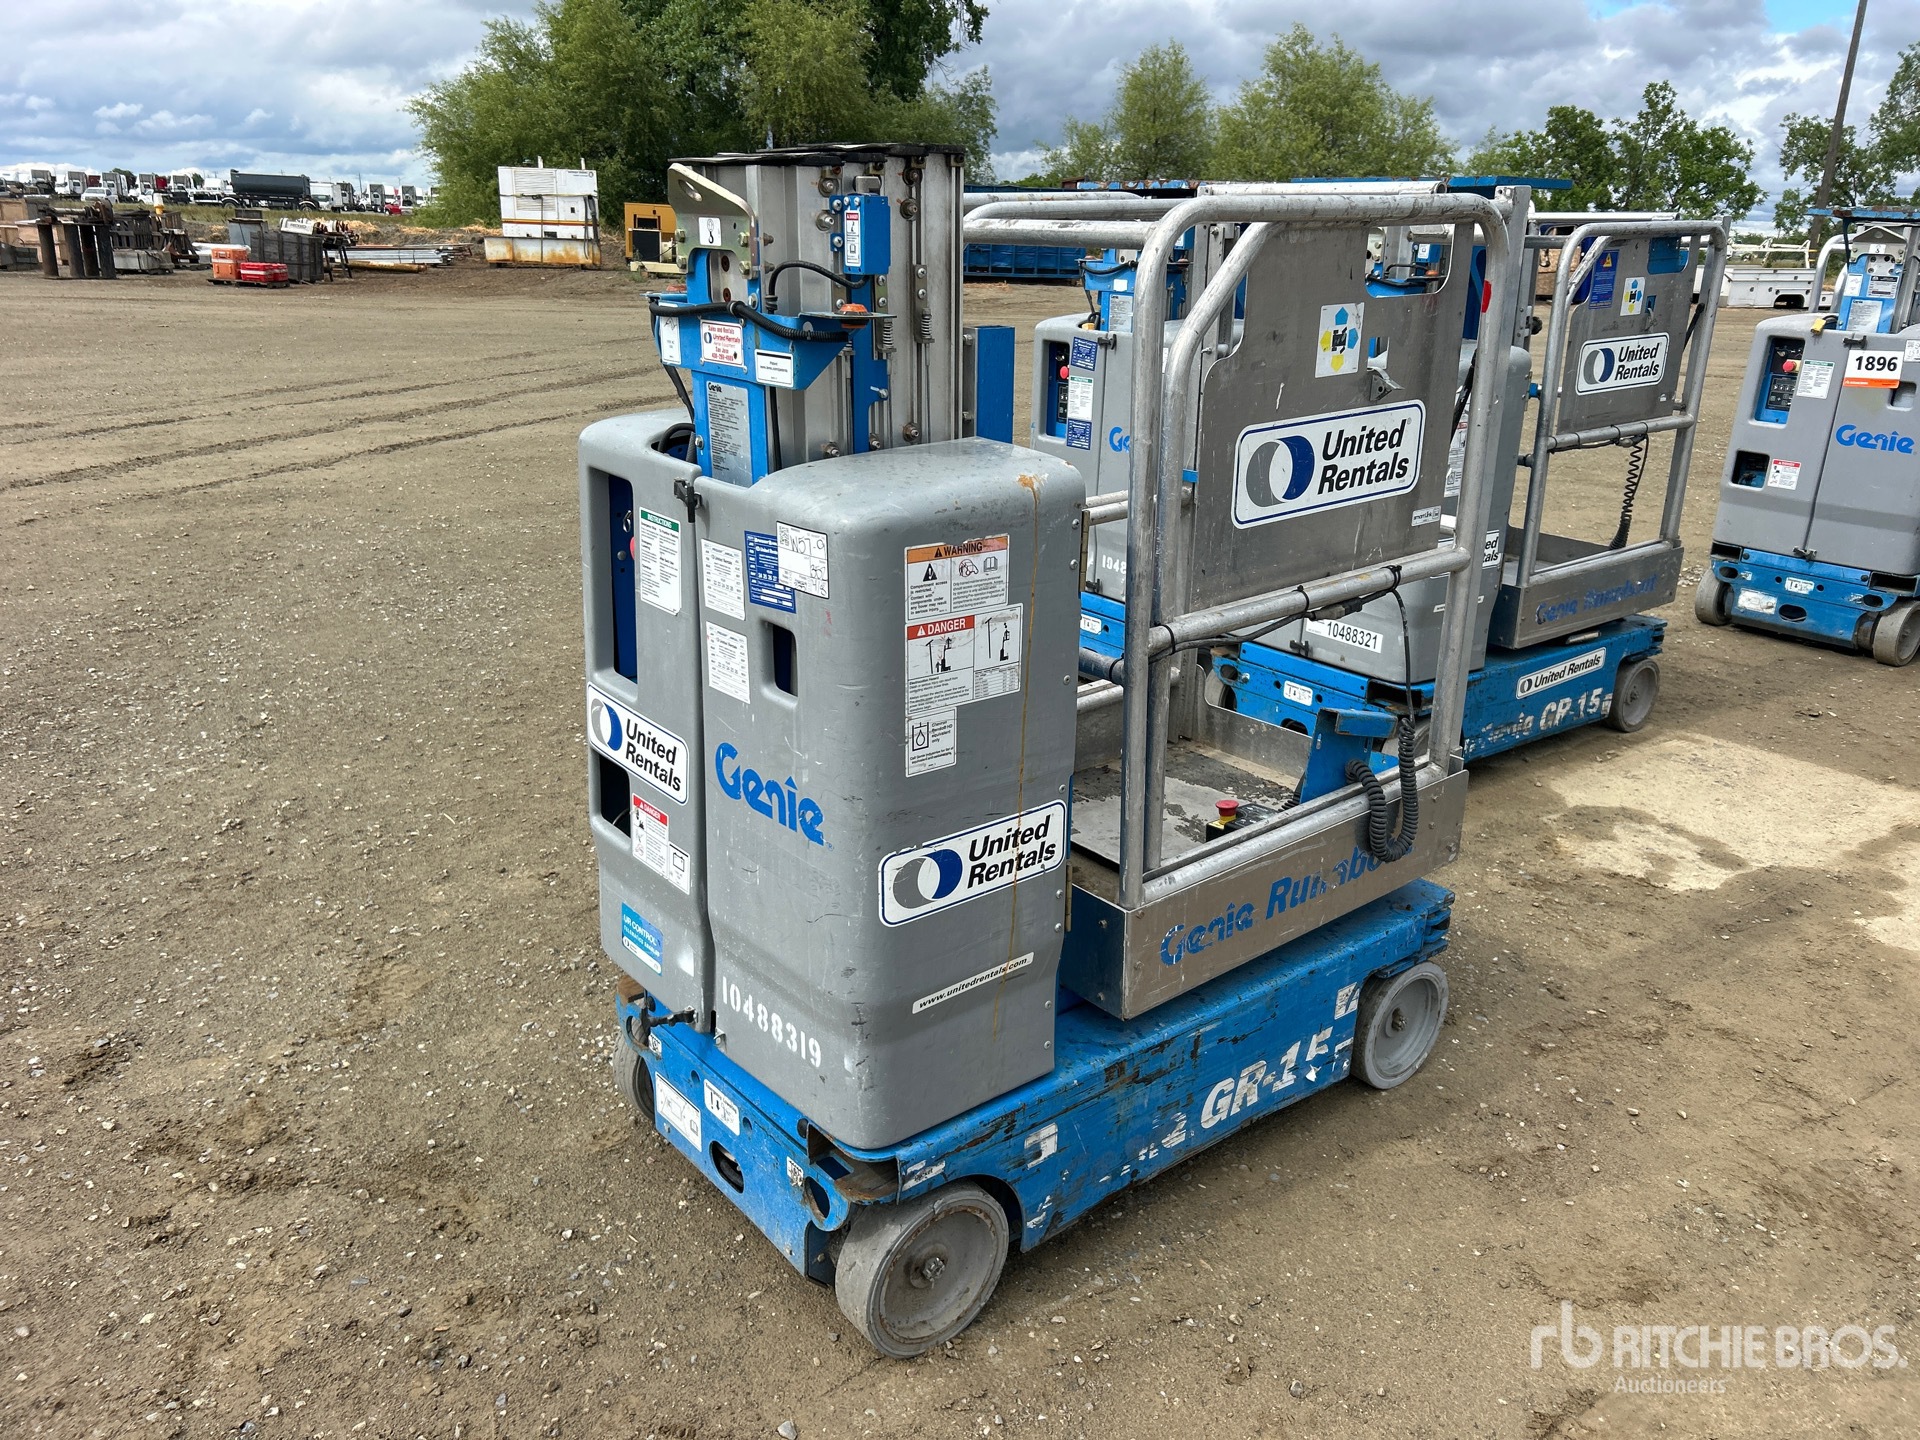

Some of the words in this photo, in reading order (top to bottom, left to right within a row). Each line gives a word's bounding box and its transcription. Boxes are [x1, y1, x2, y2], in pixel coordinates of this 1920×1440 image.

[1614, 361, 1660, 381] Rentals
[1618, 343, 1660, 363] United
[1856, 356, 1898, 371] 1896
[1322, 418, 1406, 460] United
[1836, 424, 1914, 454] Genie
[1318, 452, 1409, 494] Rentals
[648, 514, 672, 528] INSTRUCTIONS
[944, 542, 982, 556] WARNING
[928, 618, 965, 635] DANGER
[1327, 621, 1378, 649] 10488321
[1534, 666, 1566, 688] United
[1567, 654, 1602, 676] Rentals
[626, 718, 677, 765] United
[626, 741, 681, 791] Rentals
[715, 742, 824, 846] Genie
[969, 814, 1051, 862] United
[967, 841, 1056, 889] Rentals
[632, 920, 657, 946] CONTROL
[1161, 902, 1254, 965] Genie
[919, 958, 1027, 1008] www.unitedrentals.com
[723, 976, 821, 1068] 10488319
